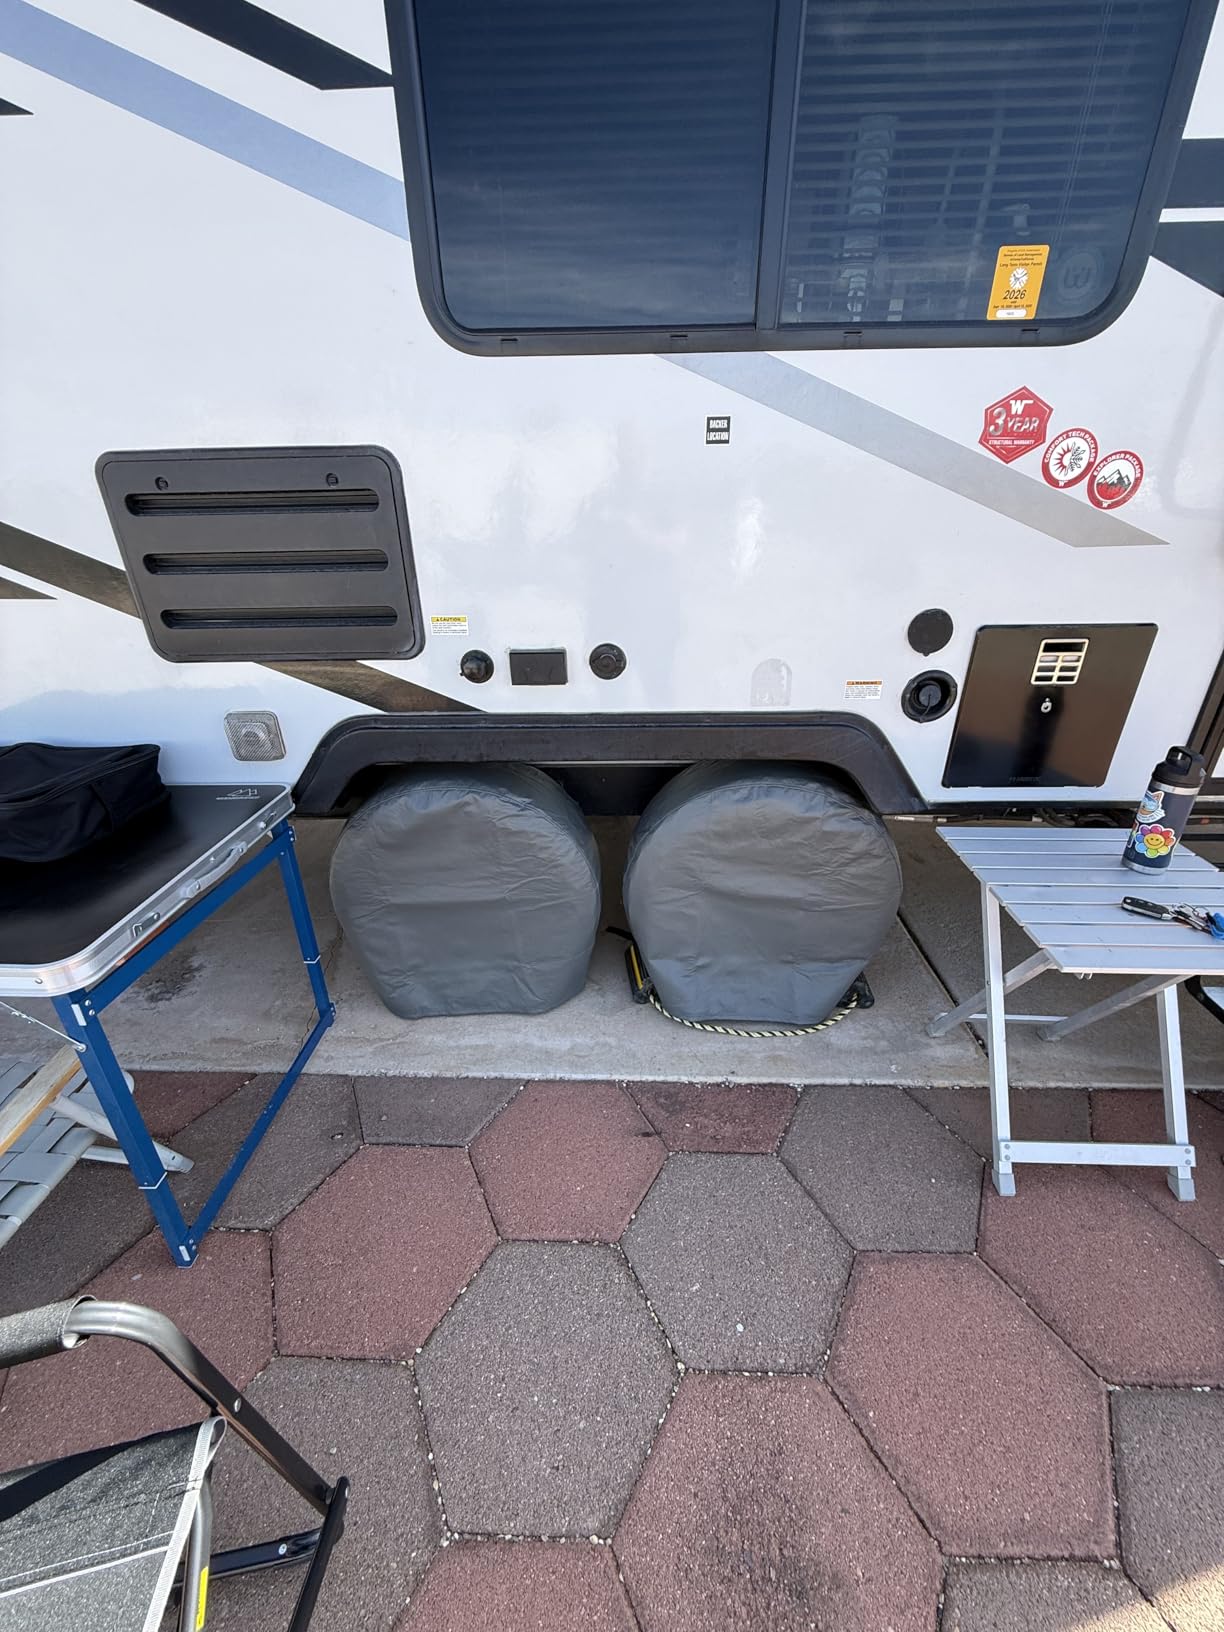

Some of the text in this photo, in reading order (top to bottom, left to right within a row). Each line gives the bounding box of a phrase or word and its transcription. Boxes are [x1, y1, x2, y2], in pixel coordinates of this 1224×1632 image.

[1003, 289, 1027, 300] 2026
[709, 419, 728, 429] BACKER
[989, 407, 1040, 436] 3 YEAR
[707, 431, 729, 441] LOCATION
[1044, 430, 1096, 463] COMFORT TECH PACKAGE
[1093, 453, 1141, 478] EXPLORER PACKAGE
